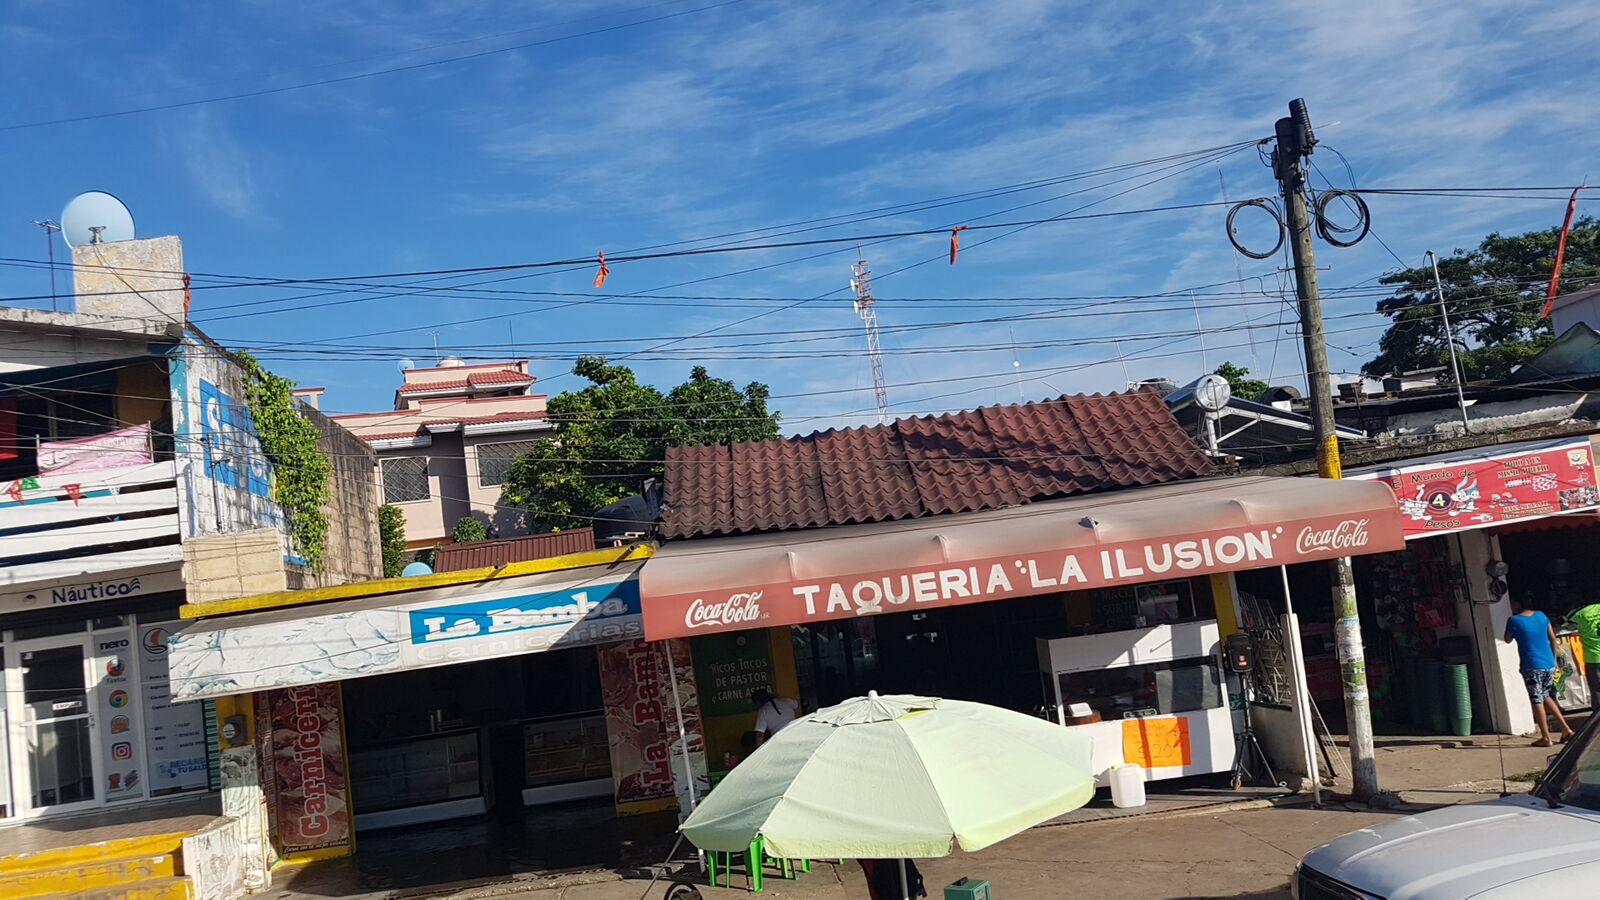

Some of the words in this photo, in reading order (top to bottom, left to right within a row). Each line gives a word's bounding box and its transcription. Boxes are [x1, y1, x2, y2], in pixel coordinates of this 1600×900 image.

[1411, 471, 1453, 484] Mundo
[1459, 467, 1476, 478] de
[1432, 493, 1446, 507] 4
[1424, 519, 1460, 528] Pesos
[793, 563, 1013, 616] TAQUERIA
[1027, 554, 1088, 588] LA
[1100, 529, 1274, 580] ILUSION
[51, 580, 130, 604] Náutico
[423, 615, 481, 642] La
[486, 591, 628, 633] Bamba
[100, 639, 129, 650] nero
[417, 619, 642, 662] Carnicerias
[716, 677, 728, 688] DE
[731, 671, 767, 686] PASTOR
[718, 689, 744, 701] CARNE
[745, 684, 773, 697] ASA
[287, 685, 330, 838] Carnicerí
[640, 741, 672, 787] La
